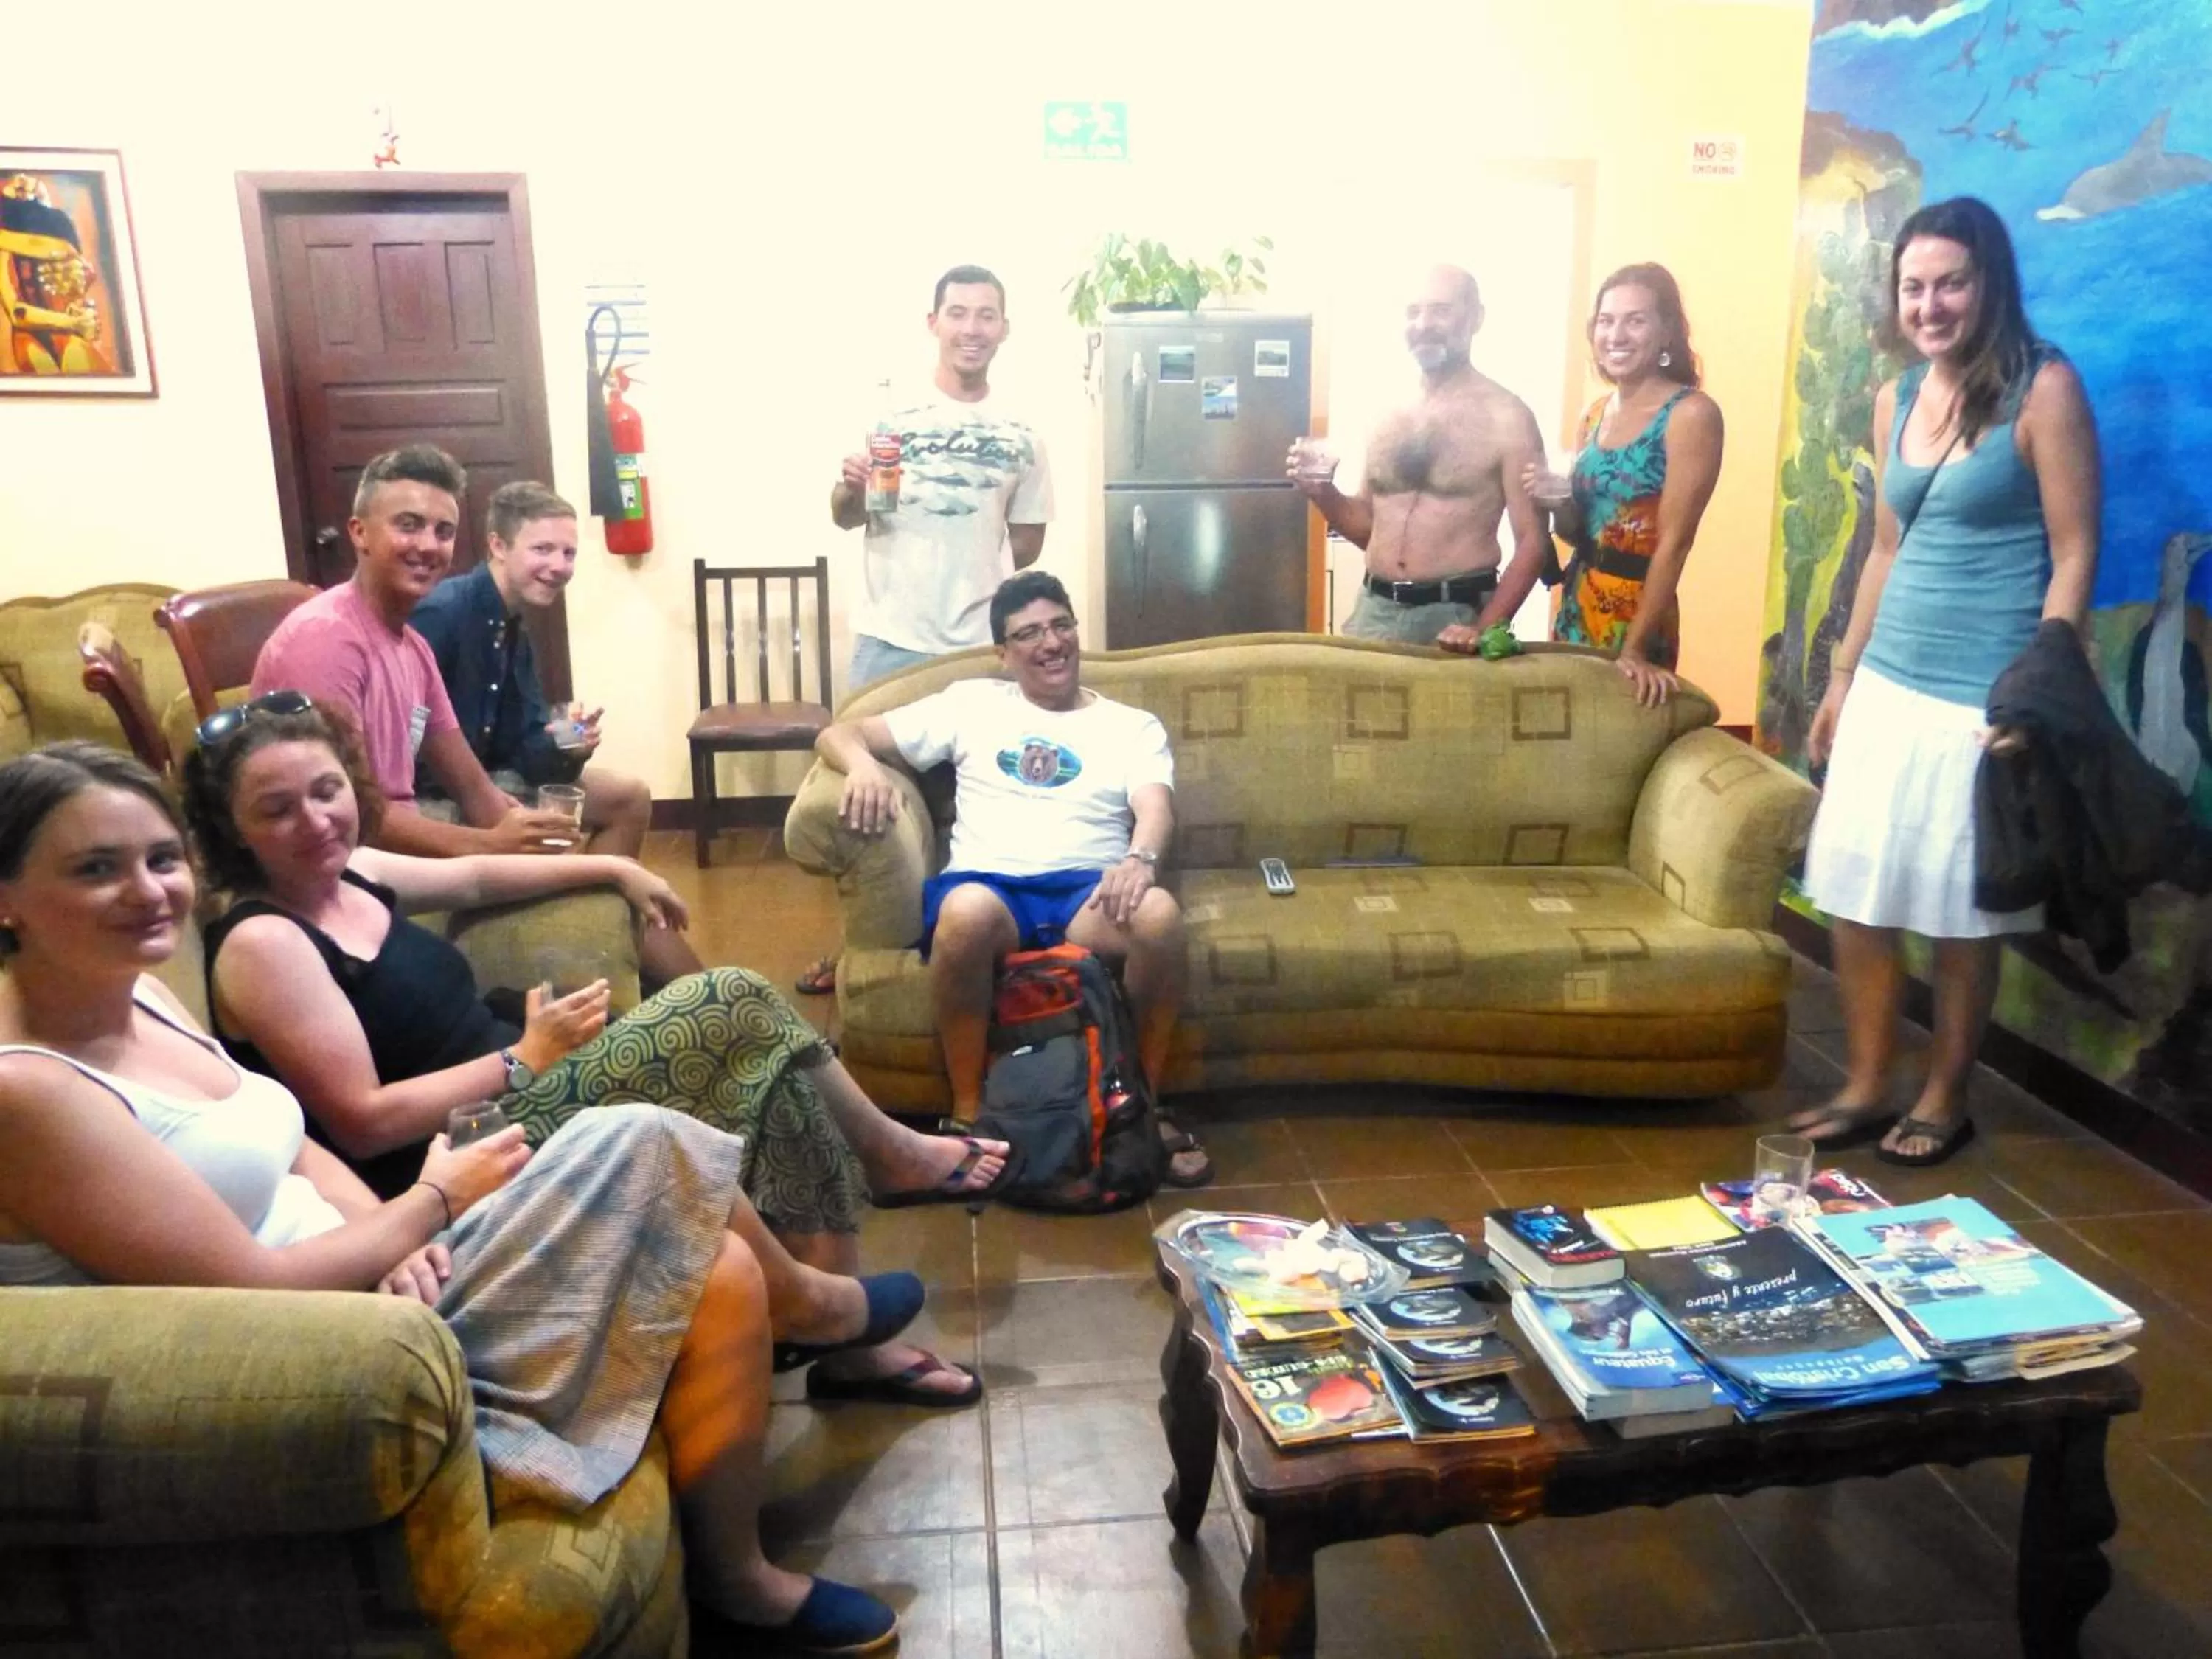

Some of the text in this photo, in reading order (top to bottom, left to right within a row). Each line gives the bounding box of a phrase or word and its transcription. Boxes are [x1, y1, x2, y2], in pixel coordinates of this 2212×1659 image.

[1694, 142, 1716, 158] NO
[1686, 1267, 1797, 1308] presente y futuro
[1861, 1355, 1910, 1373] San
